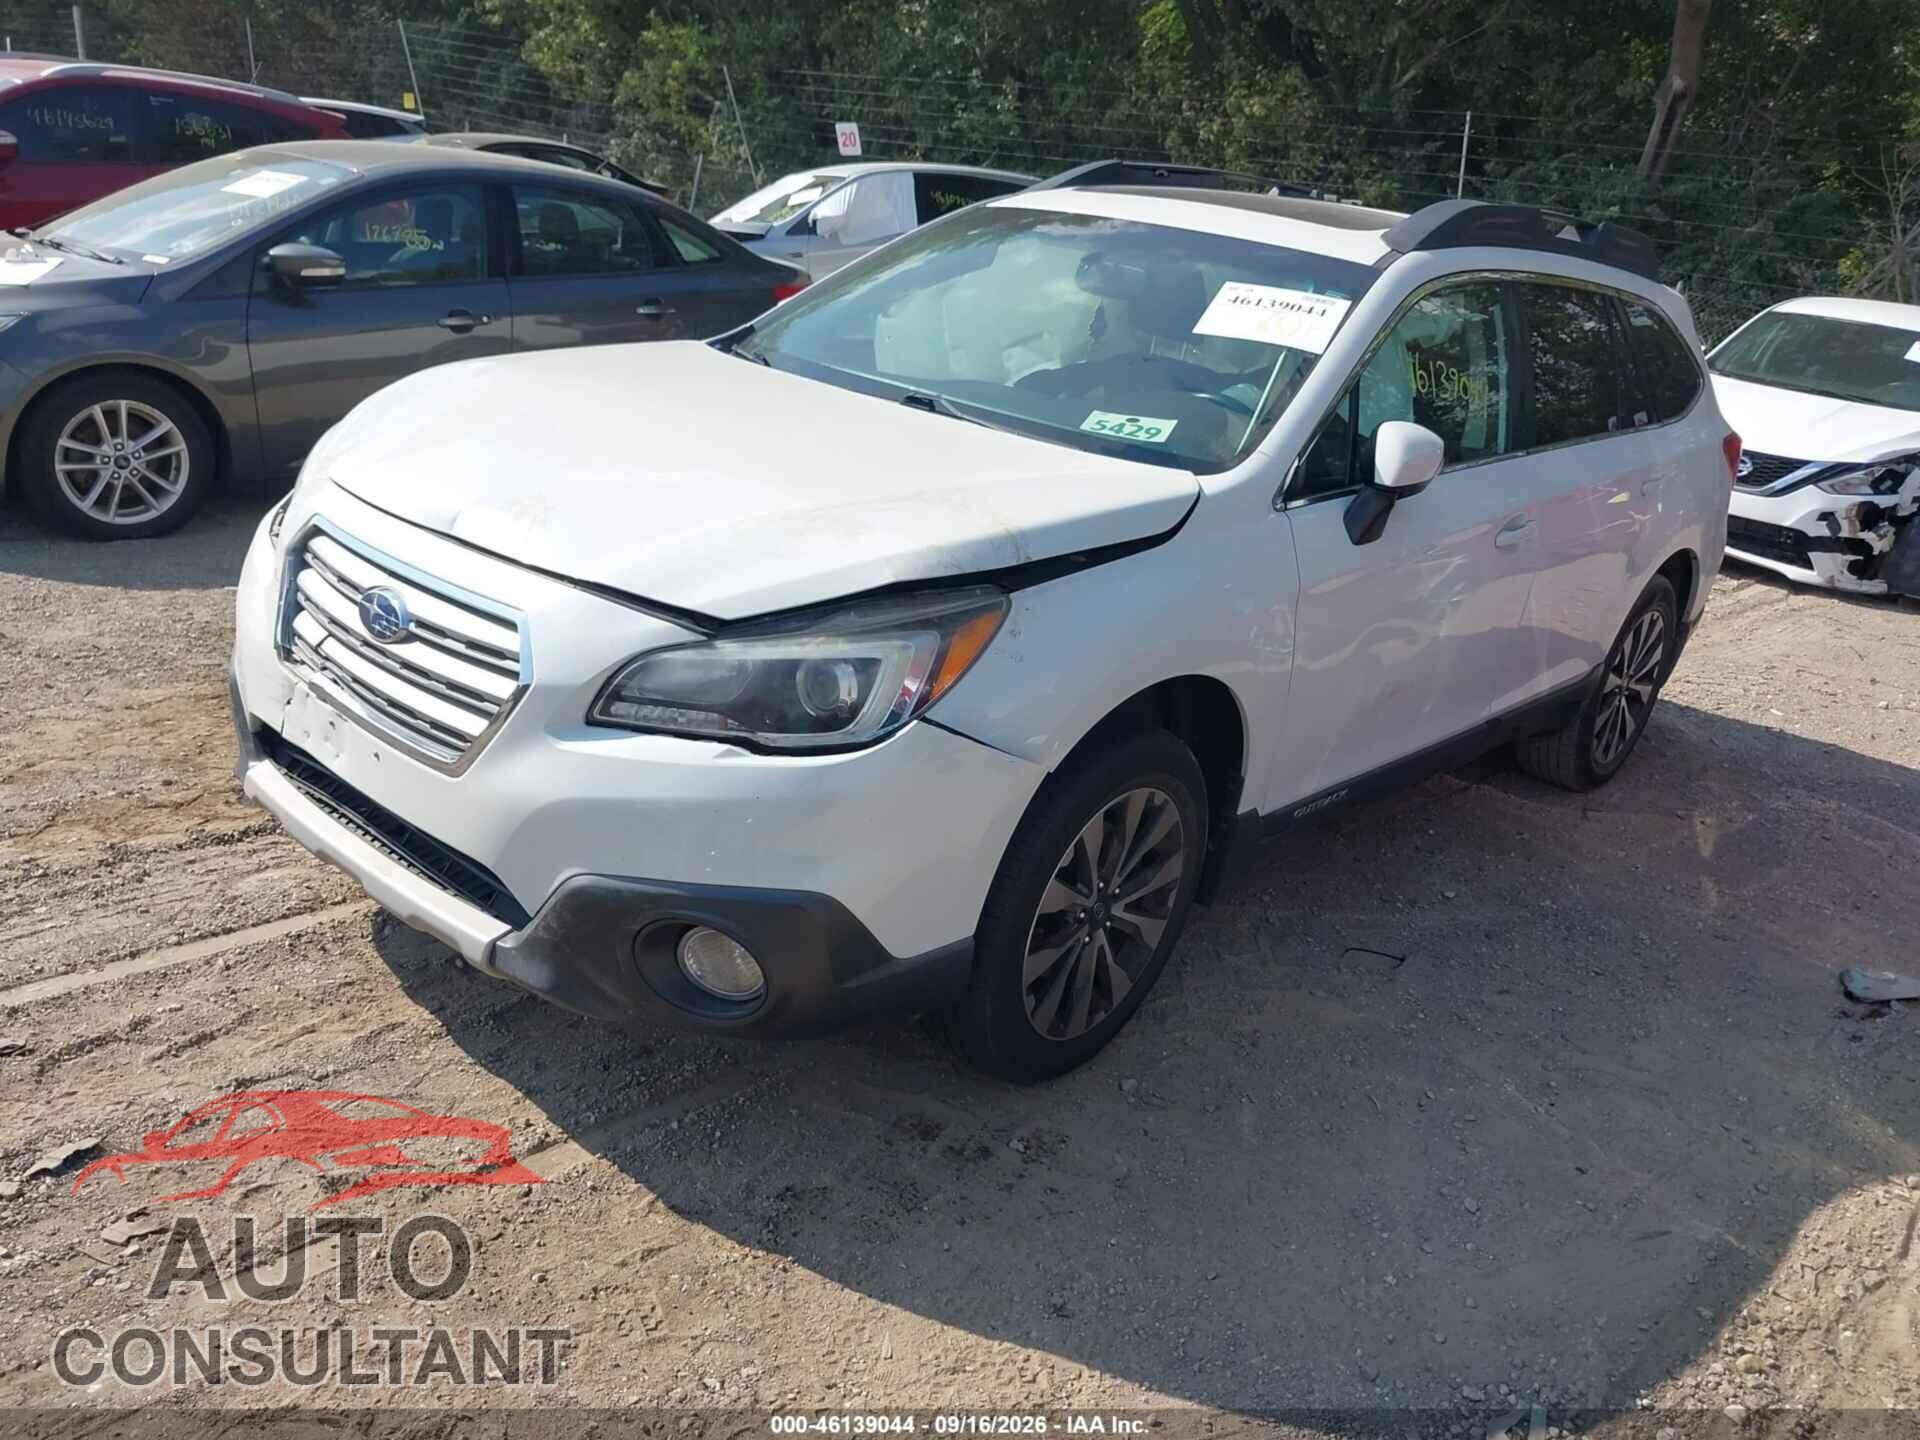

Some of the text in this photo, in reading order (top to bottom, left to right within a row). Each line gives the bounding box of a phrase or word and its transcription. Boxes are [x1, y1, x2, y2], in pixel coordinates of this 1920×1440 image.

[840, 131, 857, 148] 20
[1227, 295, 1327, 317] 46139044
[1089, 419, 1162, 439] 5429
